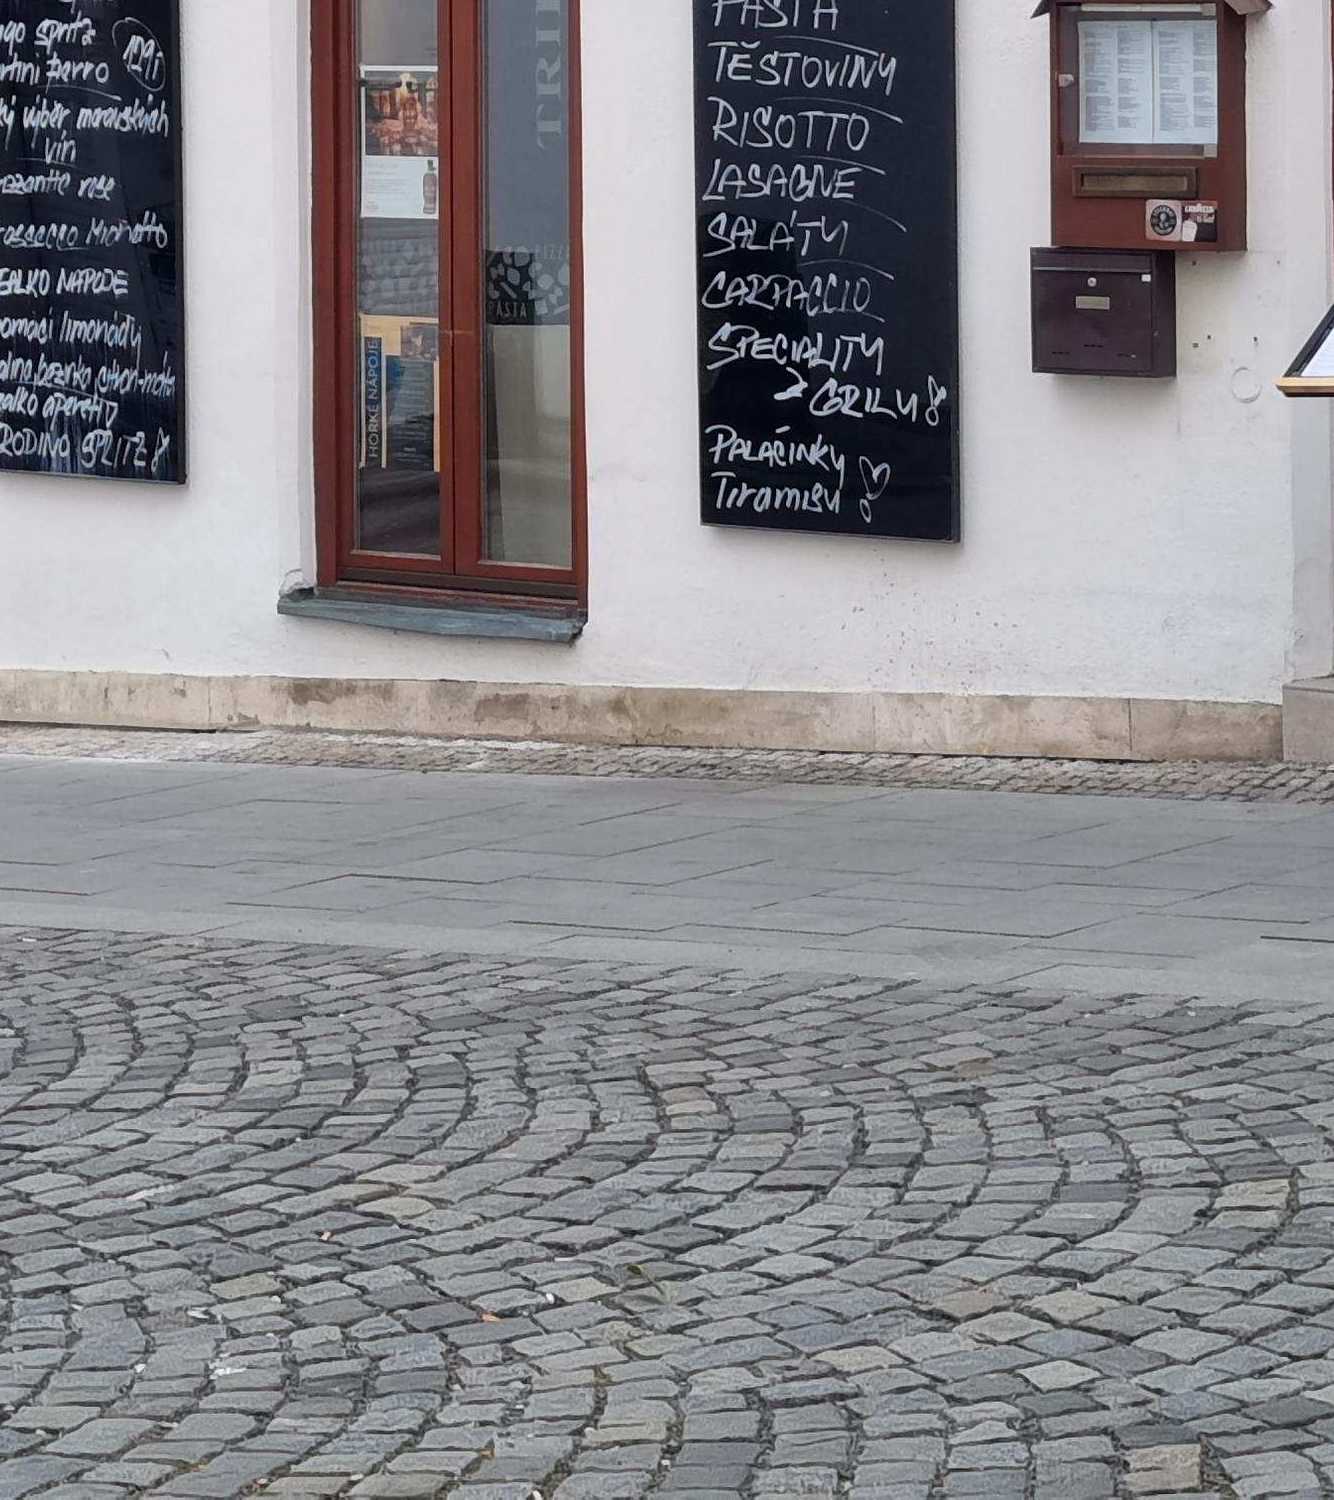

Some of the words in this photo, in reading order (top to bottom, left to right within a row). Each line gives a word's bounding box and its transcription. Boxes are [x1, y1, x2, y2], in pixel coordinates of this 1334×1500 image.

[708, 40, 897, 95] TĚSTOVINY
[707, 97, 868, 150] RISOTTO
[702, 158, 863, 202] LASAGNE
[702, 210, 849, 257] SALÁTY
[702, 271, 872, 316] CARPACCIO
[706, 322, 884, 376] SPECIALITY
